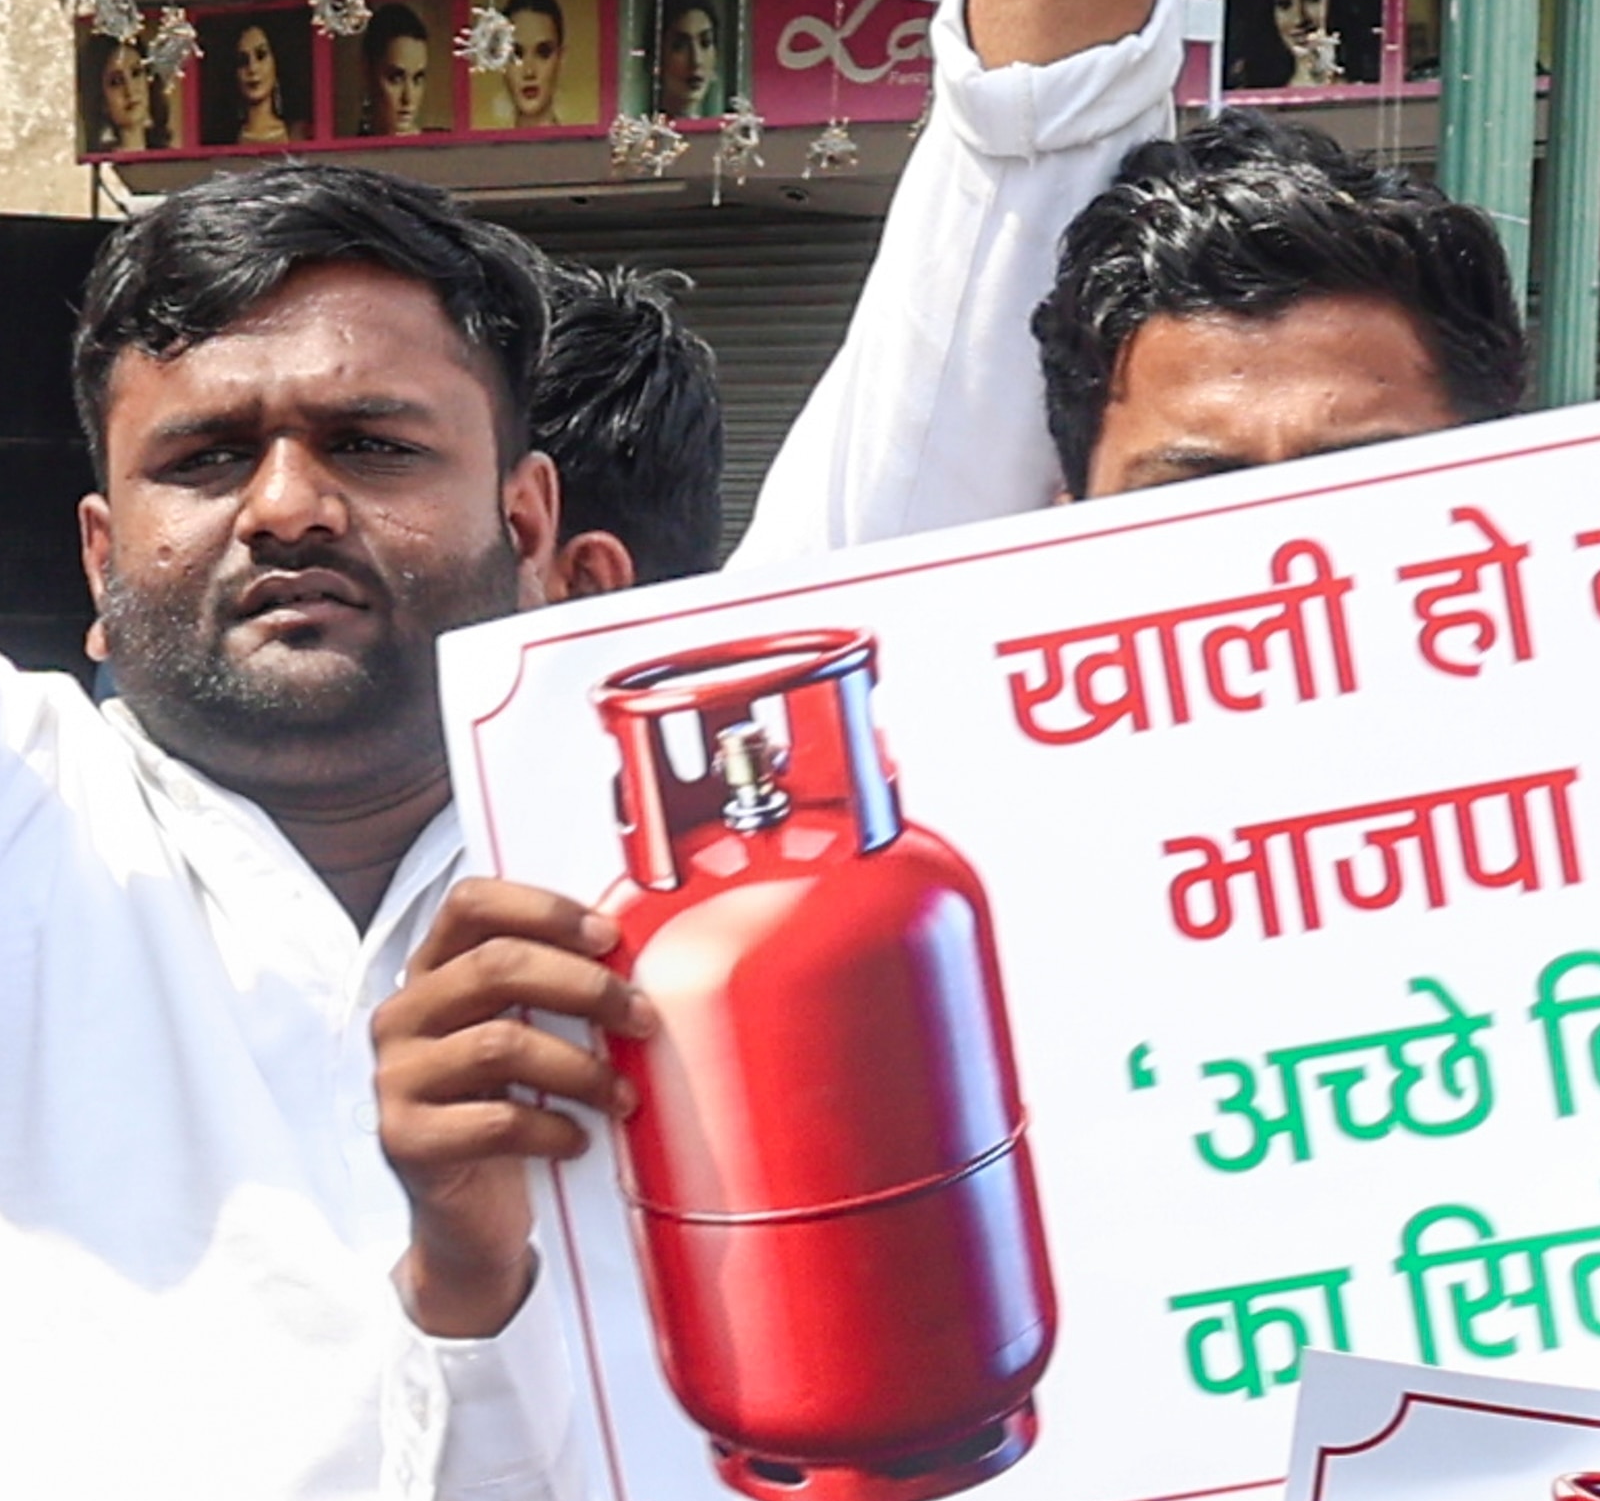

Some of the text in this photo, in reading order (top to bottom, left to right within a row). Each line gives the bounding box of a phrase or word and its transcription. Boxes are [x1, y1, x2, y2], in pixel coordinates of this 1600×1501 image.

[995, 537, 1358, 747] खाली
[1397, 505, 1534, 679] हो
[1162, 767, 1582, 942] भाजपा
[1167, 1265, 1354, 1401] का
